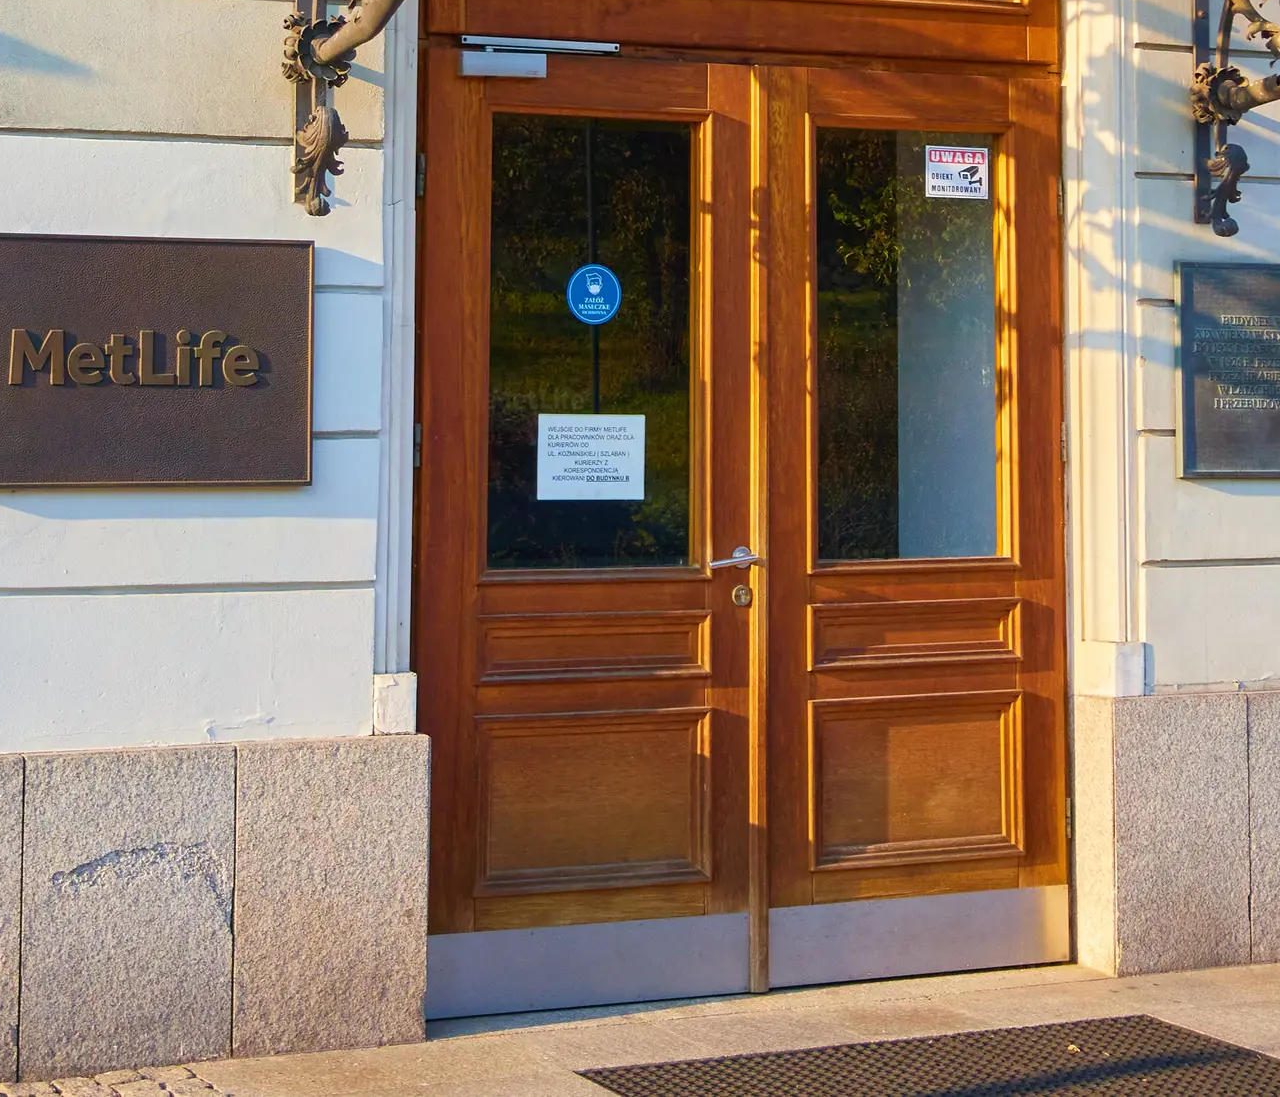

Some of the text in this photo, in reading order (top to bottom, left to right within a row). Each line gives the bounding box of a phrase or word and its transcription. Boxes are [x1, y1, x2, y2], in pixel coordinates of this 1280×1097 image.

[931, 151, 983, 163] UWAGA
[931, 185, 981, 193] MONITOROWANY
[8, 327, 260, 387] MetLife
